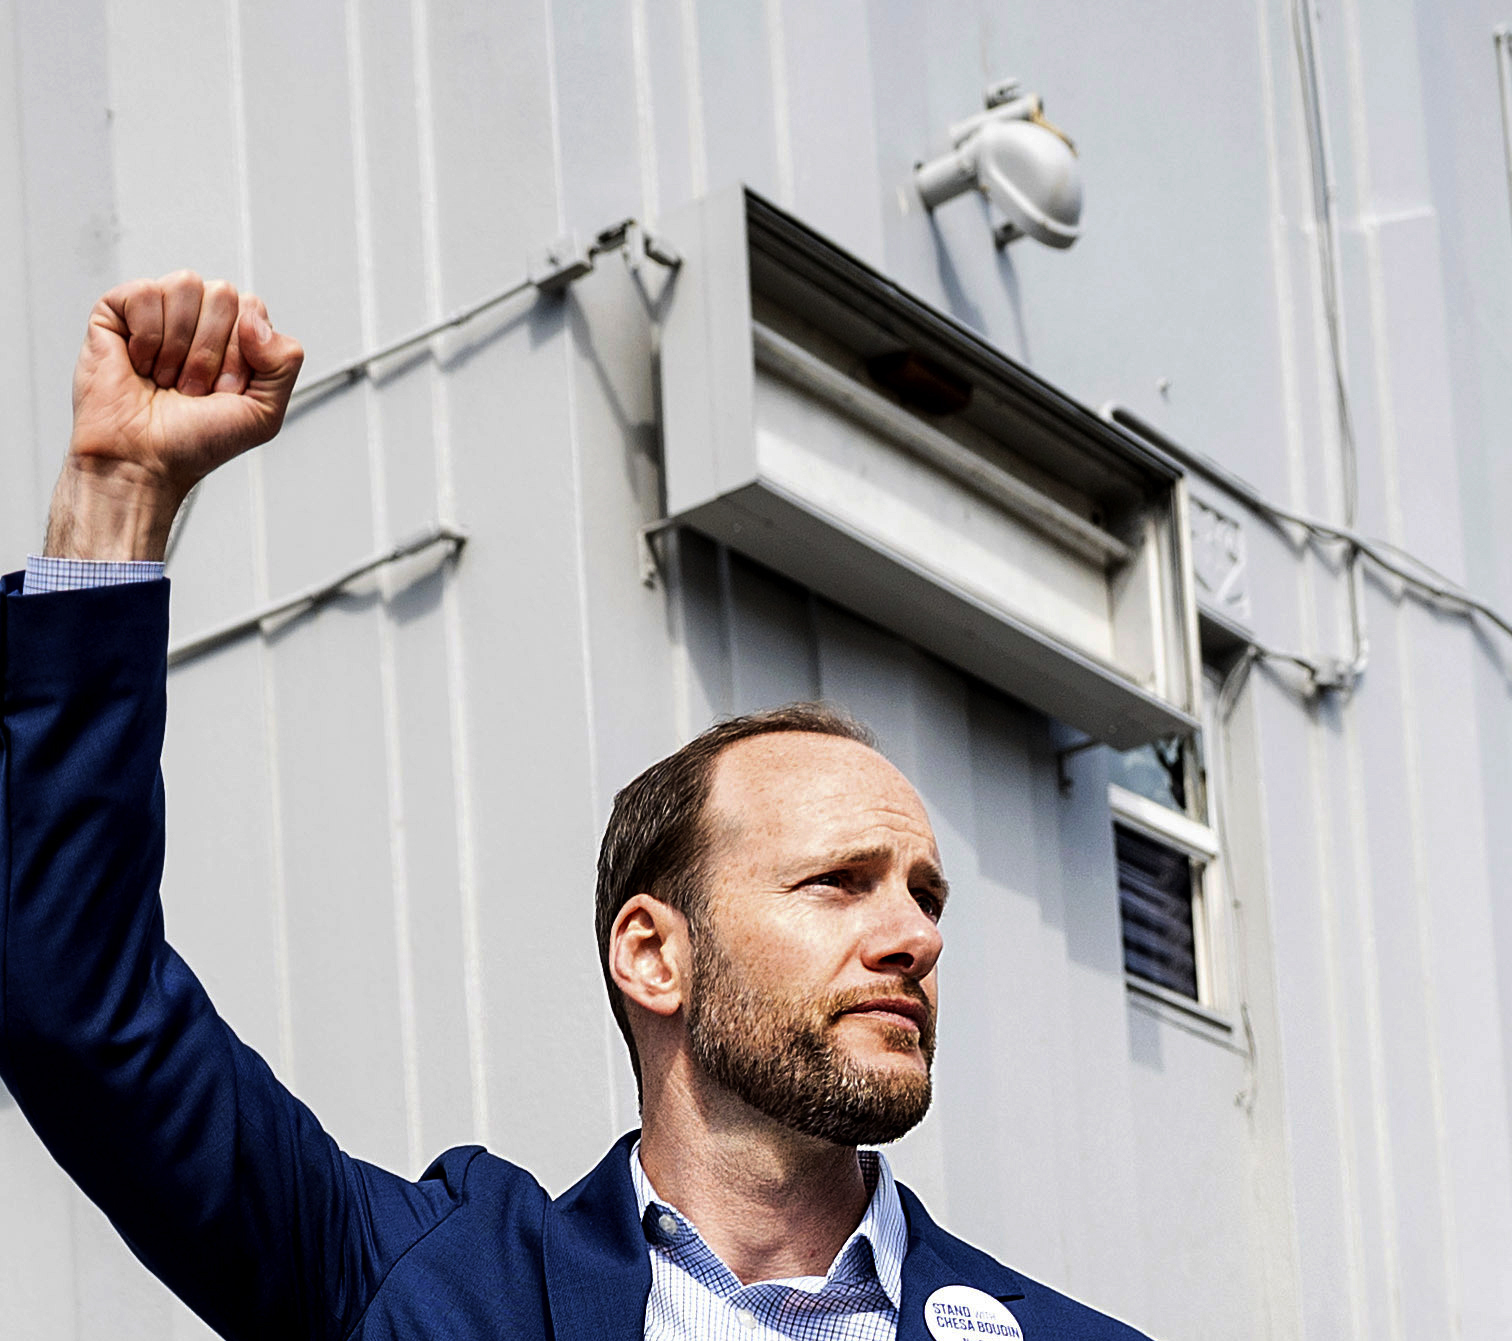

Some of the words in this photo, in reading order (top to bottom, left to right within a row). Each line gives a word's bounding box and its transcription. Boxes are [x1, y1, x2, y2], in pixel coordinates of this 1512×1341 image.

[932, 1303, 971, 1317] STAND
[936, 1316, 975, 1331] CHESA
[977, 1321, 1020, 1338] BOUDIN
